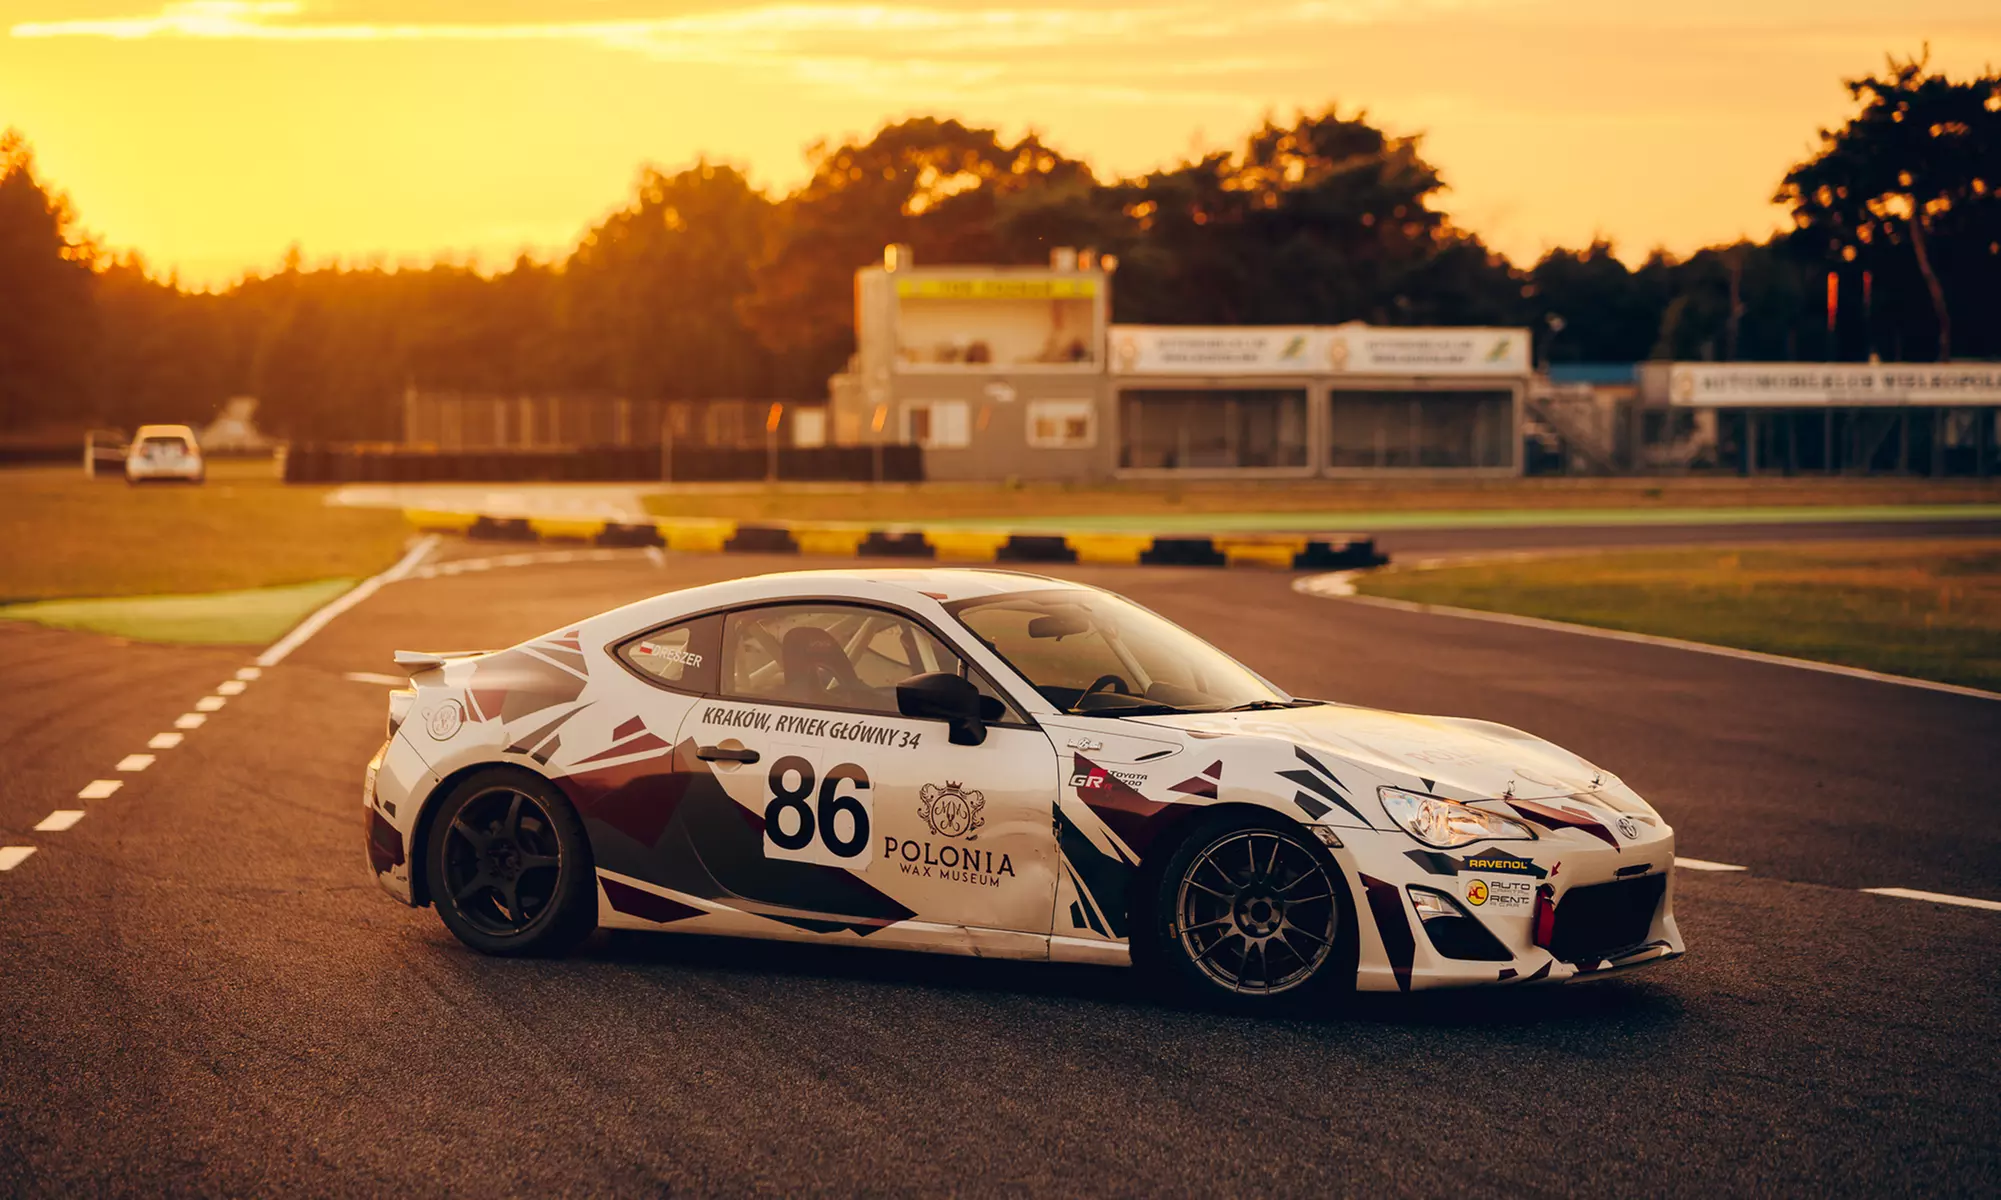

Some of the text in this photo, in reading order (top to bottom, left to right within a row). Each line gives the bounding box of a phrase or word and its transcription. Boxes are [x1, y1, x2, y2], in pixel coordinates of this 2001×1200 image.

[652, 644, 703, 668] DRESZER
[702, 706, 922, 750] KRAKÓW, RYNEK GŁÓWNY 34
[1069, 774, 1104, 788] GR
[1110, 770, 1148, 781] TOYOTA
[764, 755, 871, 859] 86
[884, 836, 1016, 878] POLONIA
[1469, 859, 1528, 870] RAVENOL
[899, 862, 1000, 888] WAX MUSEUM
[1490, 881, 1530, 891] AUTO
